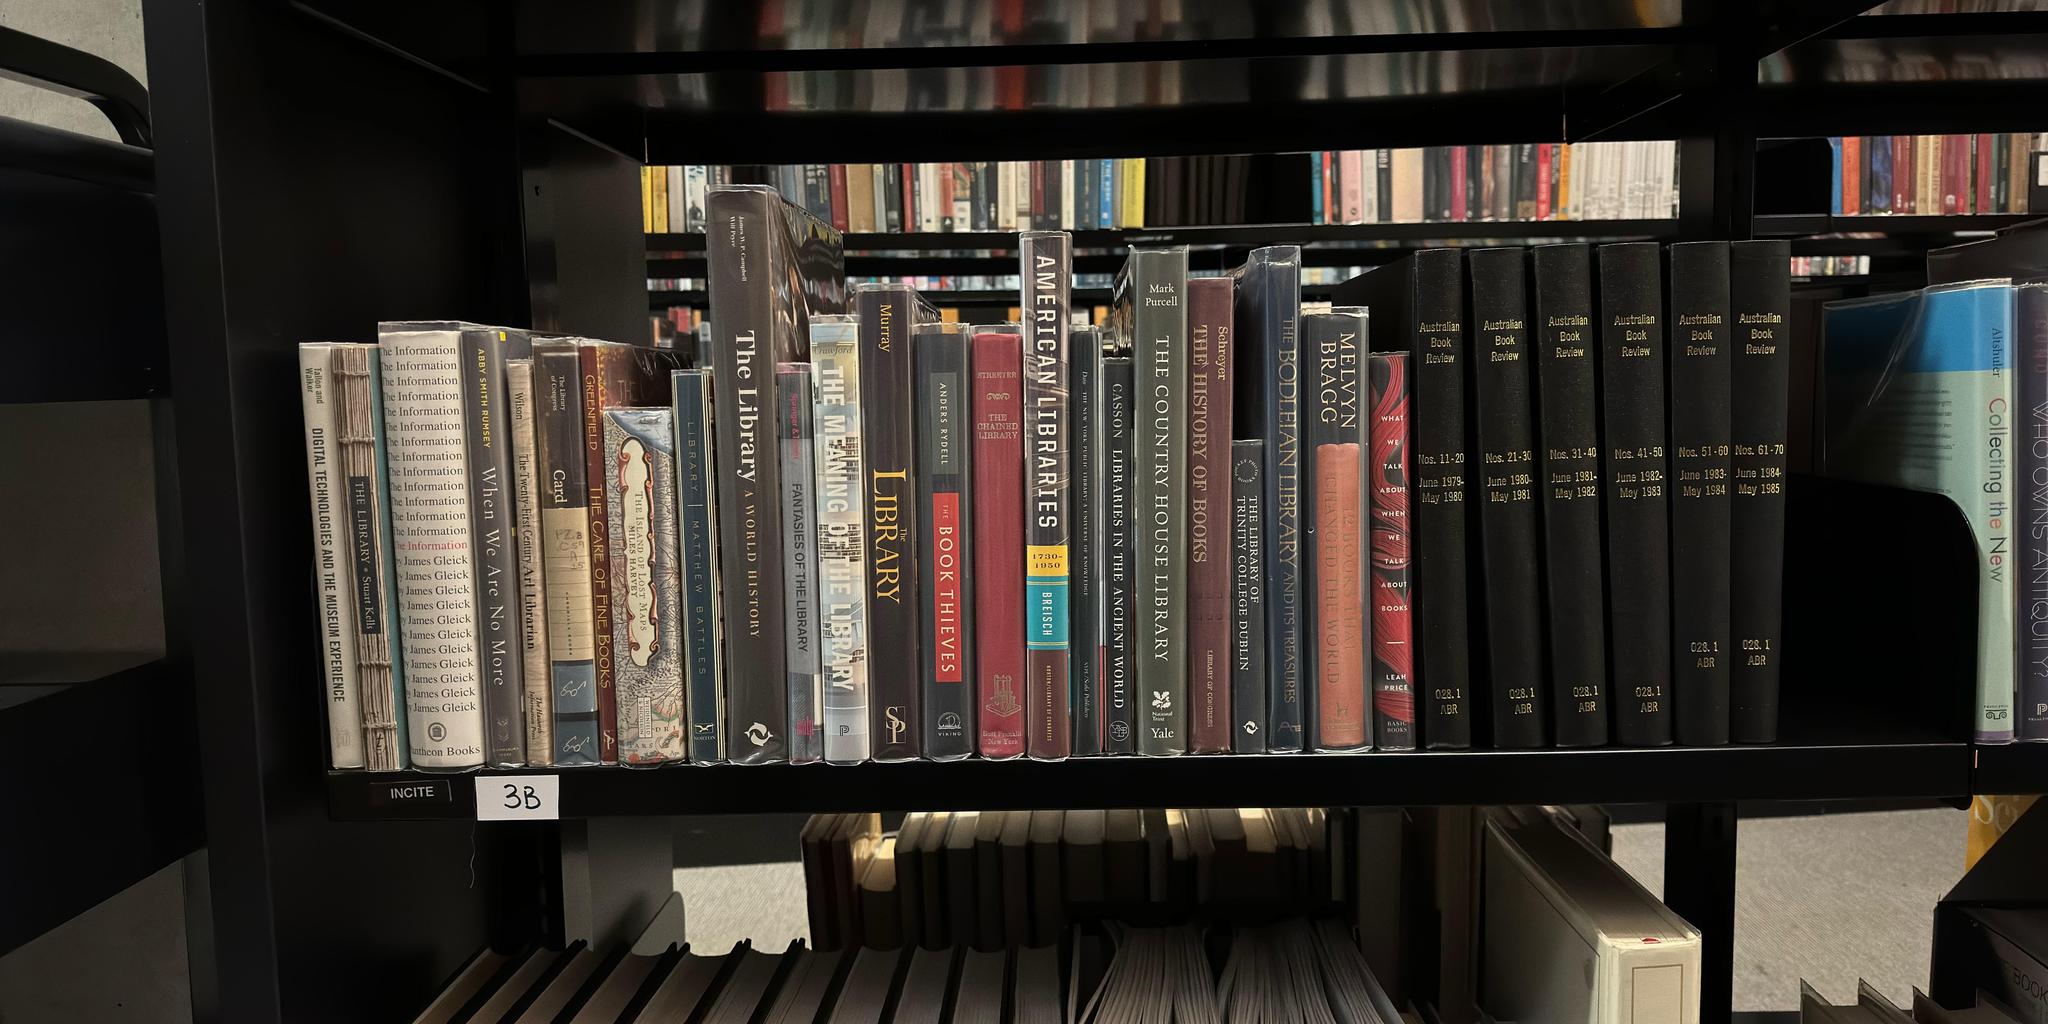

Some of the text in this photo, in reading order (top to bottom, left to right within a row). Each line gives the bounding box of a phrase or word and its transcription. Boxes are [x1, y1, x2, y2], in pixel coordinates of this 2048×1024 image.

[1145, 296, 1178, 306] Purcell
[1149, 283, 1174, 293] Mark
[878, 304, 892, 352] Murray
[1282, 318, 1293, 343] THE
[1739, 313, 1782, 324] Australian
[1751, 329, 1772, 339] Book
[395, 346, 456, 356] Information
[1217, 326, 1230, 380] Schreyer
[1746, 344, 1776, 354] Review
[1992, 328, 2003, 378] Altshuler
[304, 368, 314, 394] Walker
[313, 368, 324, 404] Tallon and
[478, 349, 490, 448] ABBY SMITH RUMSEY
[514, 392, 525, 420] Wilson
[822, 366, 846, 406] THE
[1036, 255, 1058, 528] AMERICAN LIBRARIES
[1320, 342, 1338, 424] BRAGG
[1340, 332, 1356, 430] MELVYN
[584, 375, 598, 450] GREENFIELD
[940, 383, 950, 465] ANDERS RYDELL
[976, 422, 1018, 430] CHAINED
[988, 414, 1008, 422] THE
[1278, 349, 1298, 466] BODLEIAN
[978, 431, 1018, 440] LIBRARY
[1192, 325, 1208, 562] THE HISTORY OF BOOKS
[1736, 444, 1784, 456] Nos. 61-70
[552, 469, 568, 504] Card
[736, 329, 760, 638] The Library A WORLD HISTORY
[824, 415, 849, 512] MEANING
[1418, 476, 1464, 488] June 1979-
[1736, 468, 1782, 478] June 1984-
[1154, 335, 1170, 662] THE COUNTRY HOUSE LIBRARY
[1422, 491, 1462, 504] May 1980
[1738, 483, 1780, 496] May 1985
[1984, 398, 2008, 582] Collecting the New
[872, 468, 908, 604] LIBRARY
[900, 528, 908, 542] The
[1112, 383, 1126, 708] CASSON LIBRARIES IN THE ANCIENT WORLD
[1236, 496, 1248, 551] TRINITY
[1278, 473, 1298, 568] LIBRARY
[312, 428, 346, 703] DIGITAL TECHNOLOGIES AND THE MUSEUM EXPERIENCE
[354, 482, 376, 630] THE LIBRARY Stuart Kells
[404, 555, 468, 566] James Gleick
[518, 454, 538, 650] The Twenty-First Century Art Librarian
[628, 525, 638, 598] MILES HARVEY
[634, 492, 650, 632] THE ISLAND OF LOST MAPS
[688, 422, 707, 675] LIBRARY MATTHEW BATTLES
[792, 483, 808, 652] FANTASIES OF THE LIBRARY
[1248, 496, 1260, 604] THE LIBRARY OF
[482, 466, 506, 686] When We Are No More
[590, 484, 610, 689] THE CARE OF FINE BOOKS
[939, 504, 956, 673] THE BOOK THIEVES
[1238, 555, 1248, 616] COLLEGE
[1284, 571, 1296, 603] AND
[1042, 592, 1053, 636] BREISCH
[830, 603, 854, 692] LIBRARY
[1238, 620, 1250, 671] DUBLIN
[1283, 628, 1297, 703] TREASURES
[1742, 639, 1770, 651] 028.1
[1747, 655, 1766, 666] ABR
[1151, 728, 1174, 739] Yale
[390, 786, 434, 799] INCITE
[504, 784, 541, 810] 3B
